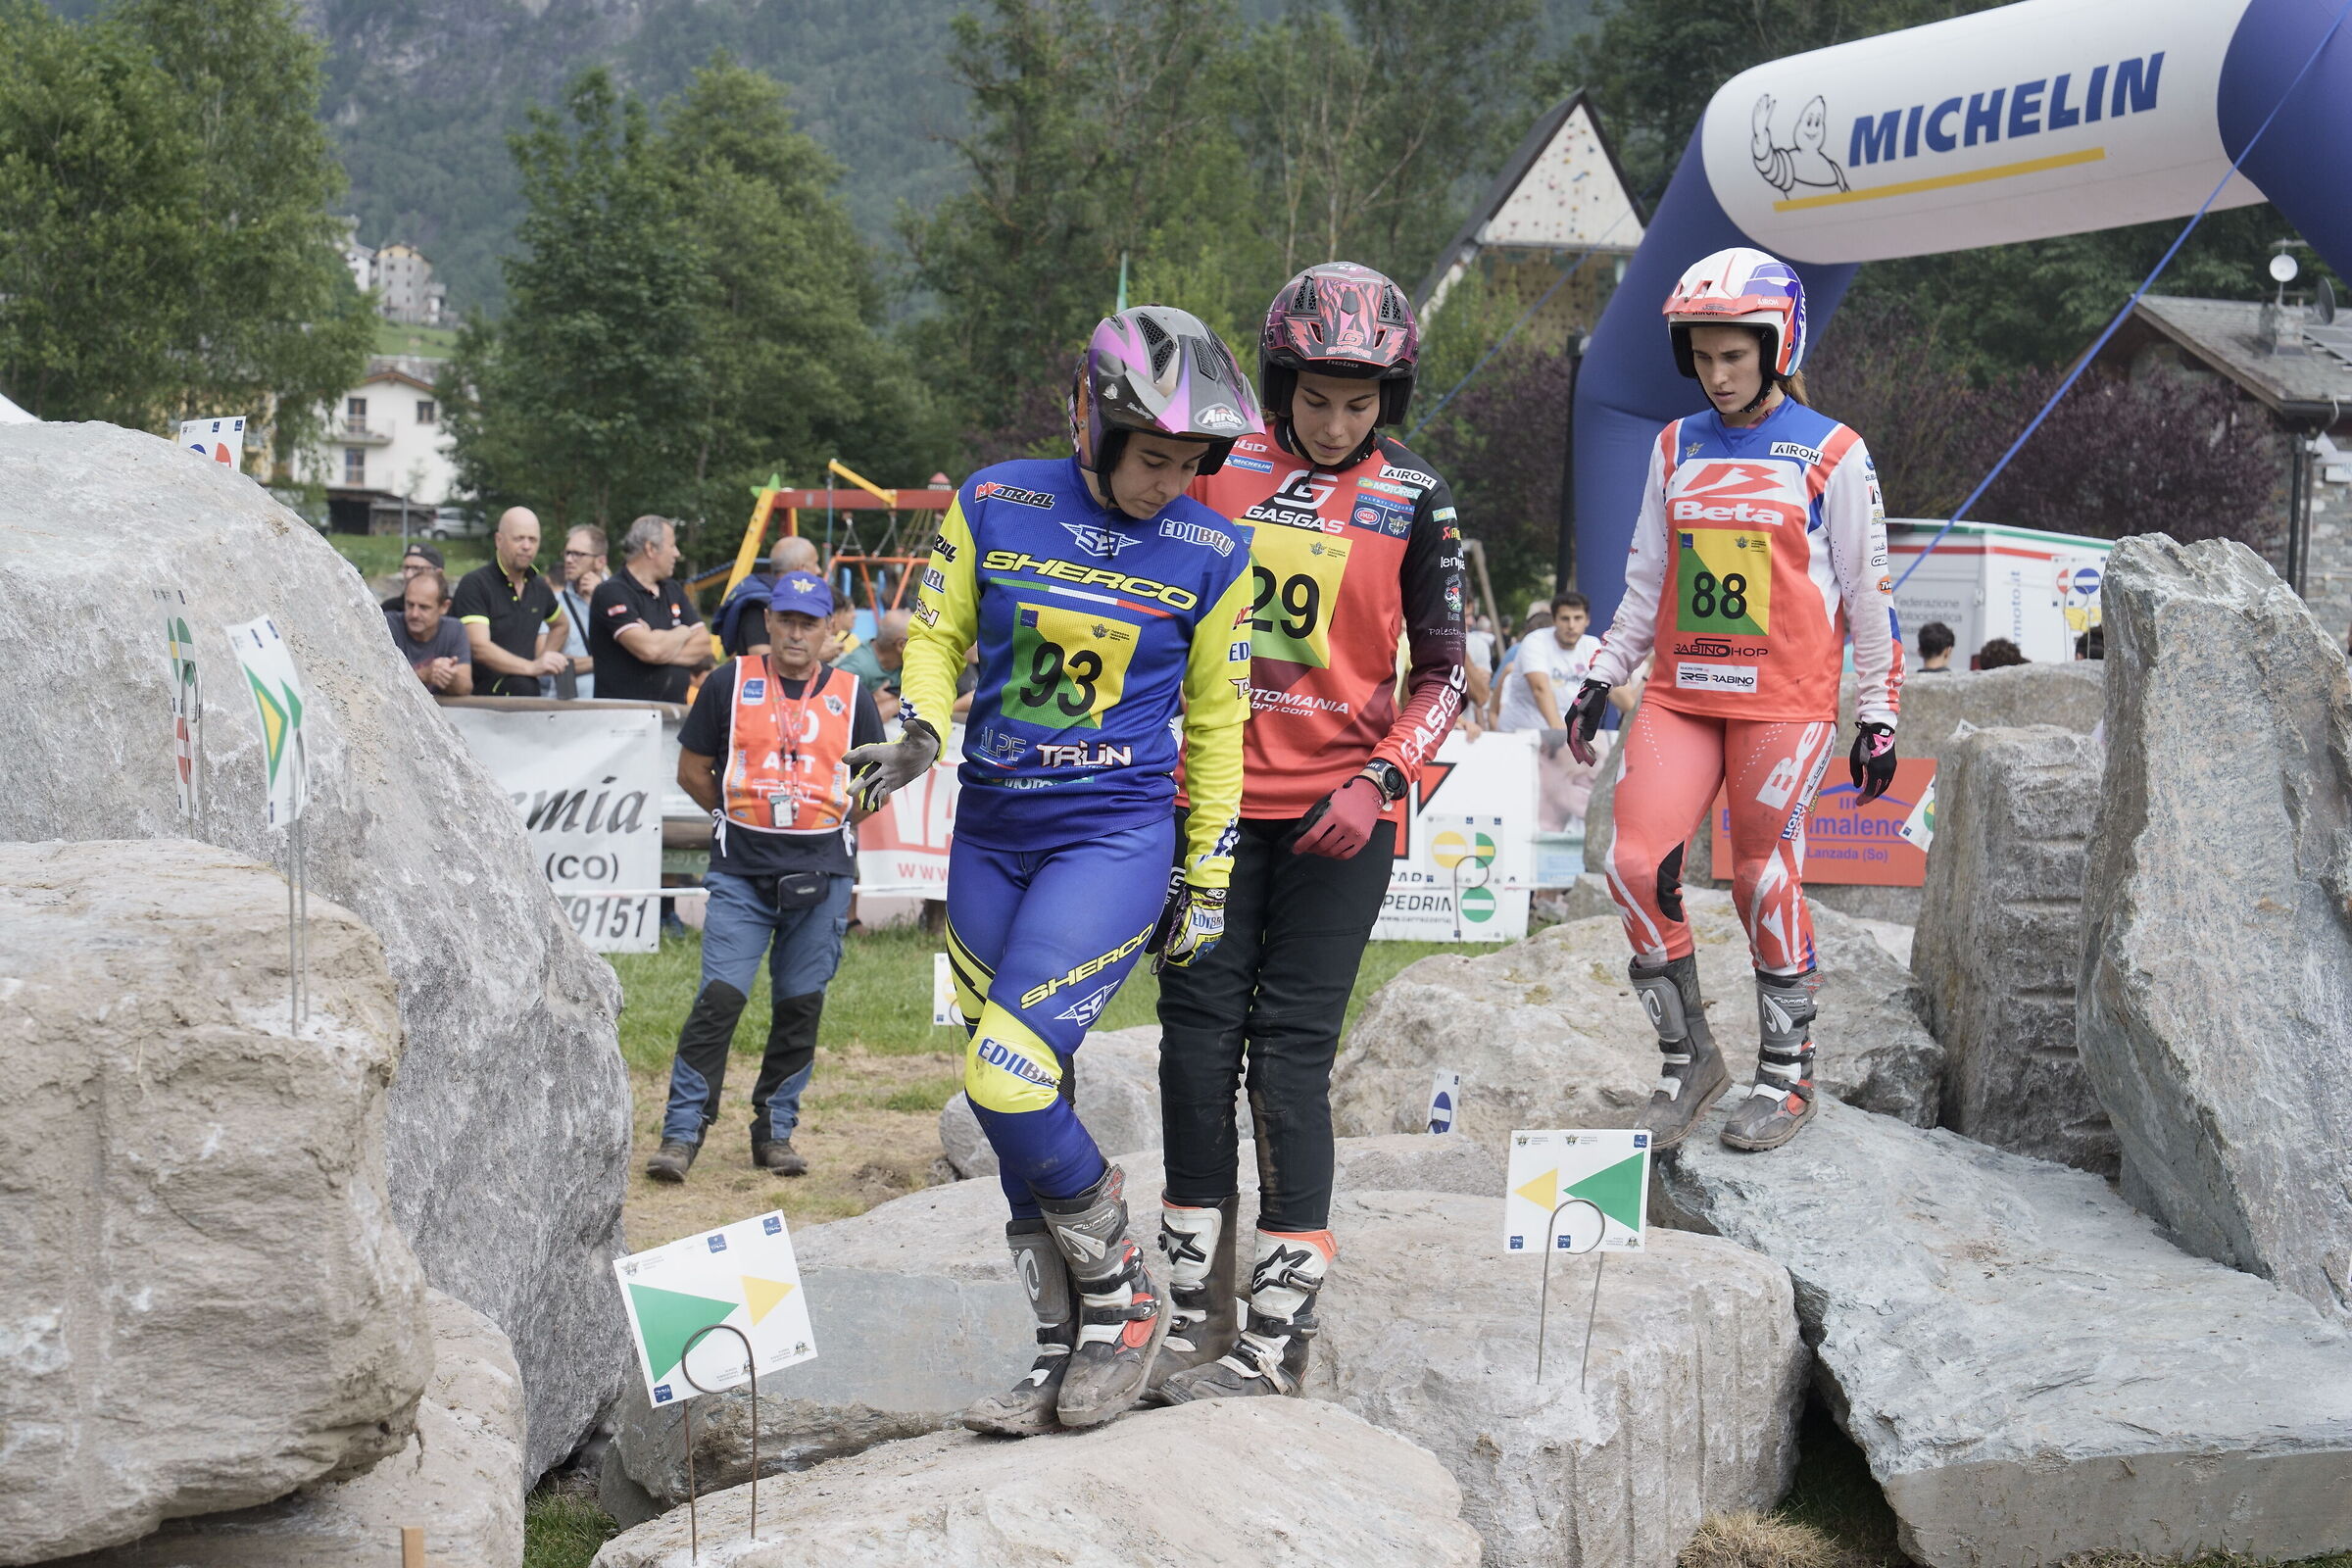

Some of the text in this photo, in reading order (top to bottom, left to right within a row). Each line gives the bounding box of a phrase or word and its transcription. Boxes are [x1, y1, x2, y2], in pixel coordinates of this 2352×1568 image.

[1848, 51, 2165, 168] MICHELIN
[1201, 409, 1243, 425] Airoh
[1233, 458, 1272, 469] MICHELIN
[1774, 444, 1820, 464] AIROH
[1373, 480, 1422, 500] MOTOREX
[1384, 467, 1435, 488] AIROH
[1245, 505, 1347, 534] GASGAS
[1673, 501, 1785, 526] Beta
[982, 551, 1198, 612] SHERCO
[1691, 571, 1747, 619] 88
[1252, 566, 1320, 639] 29
[1019, 641, 1102, 717] 93
[1712, 674, 1755, 685] RABINO
[1250, 700, 1315, 716] bry.com
[510, 775, 649, 834] mia
[1781, 803, 1804, 840] LIQUI
[545, 852, 619, 883] (CO)
[1806, 847, 1888, 862] Lanzada (So)
[1020, 922, 1154, 1009] SHERCO
